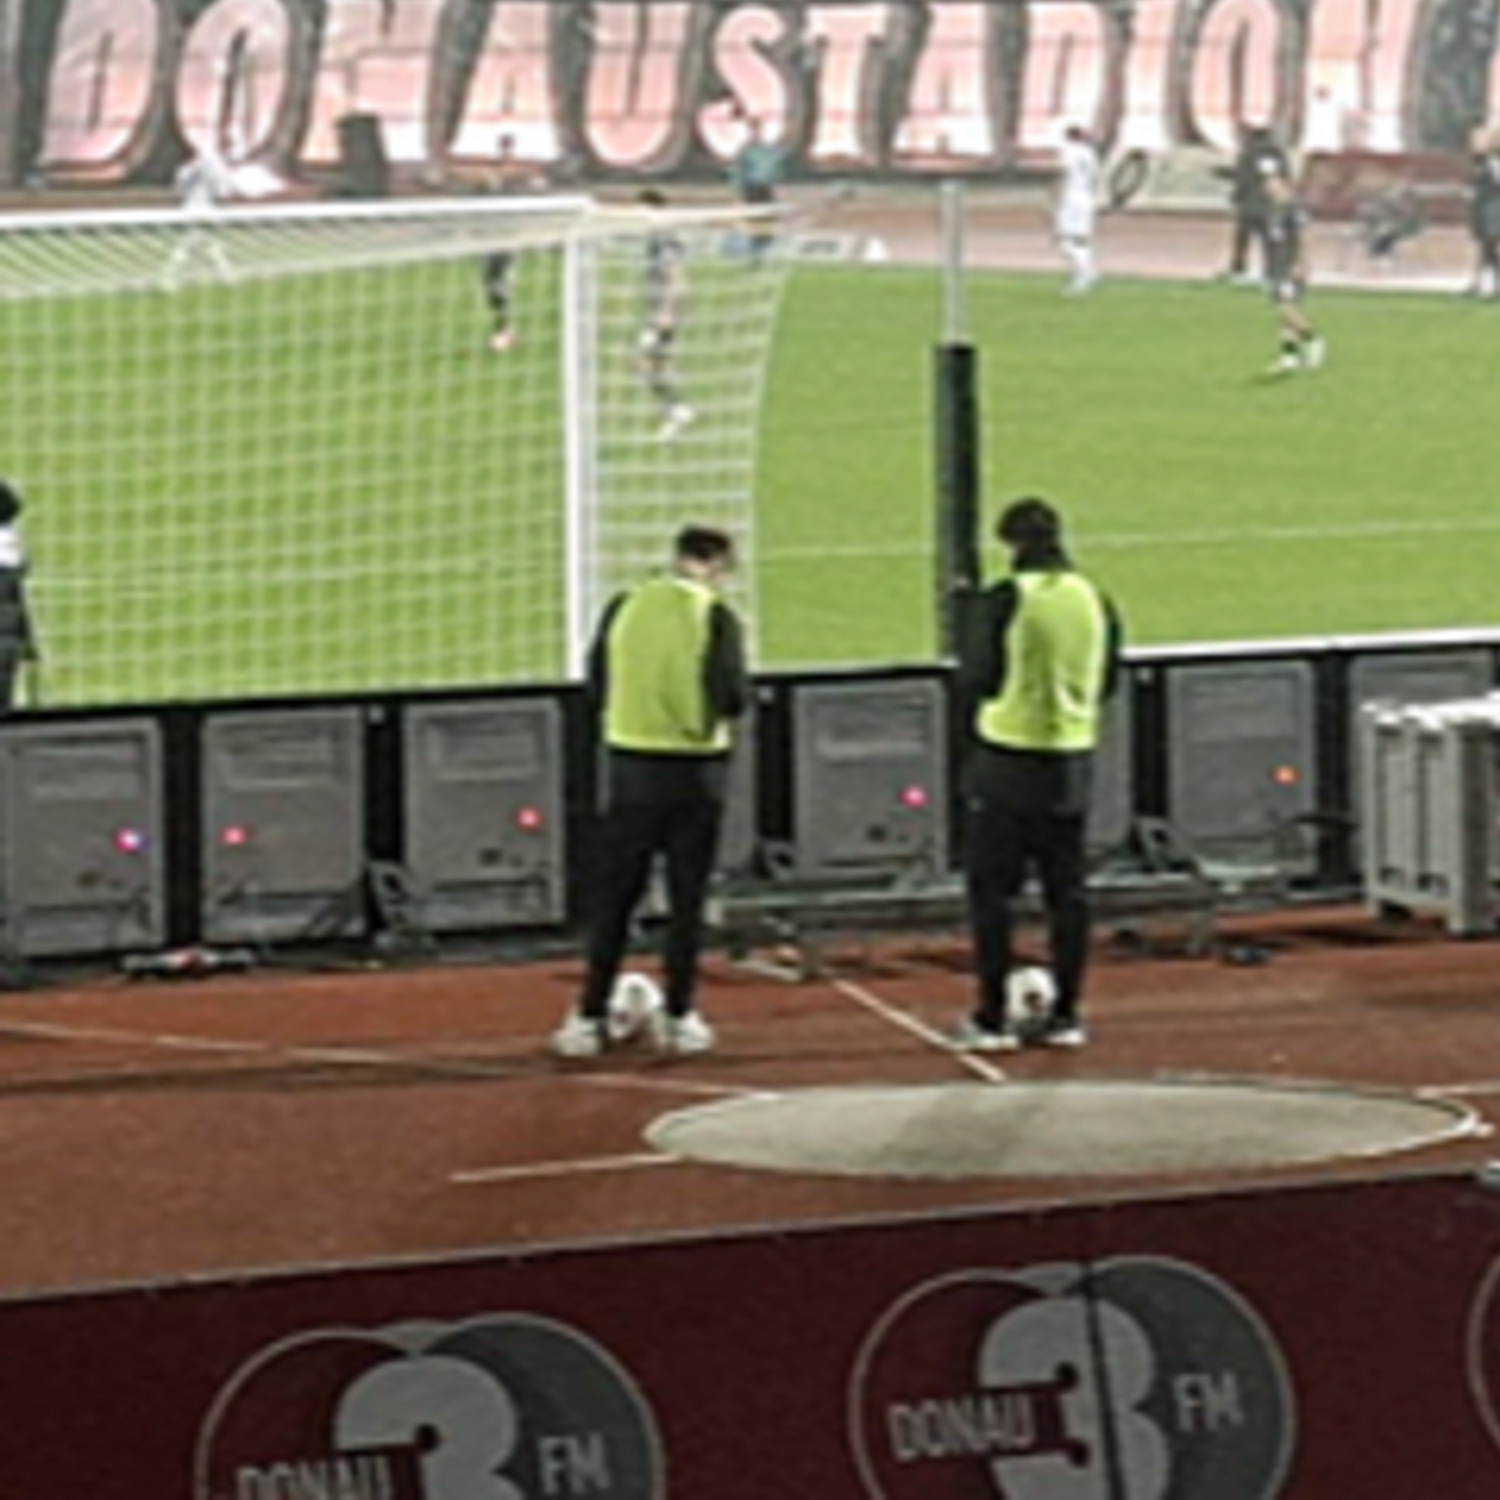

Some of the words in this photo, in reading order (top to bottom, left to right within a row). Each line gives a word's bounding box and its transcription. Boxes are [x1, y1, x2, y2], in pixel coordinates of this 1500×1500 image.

[537, 1432, 613, 1496] FM
[888, 1393, 1037, 1462] DONAU
[977, 1296, 1173, 1500] 3
[1173, 1370, 1244, 1432] FM
